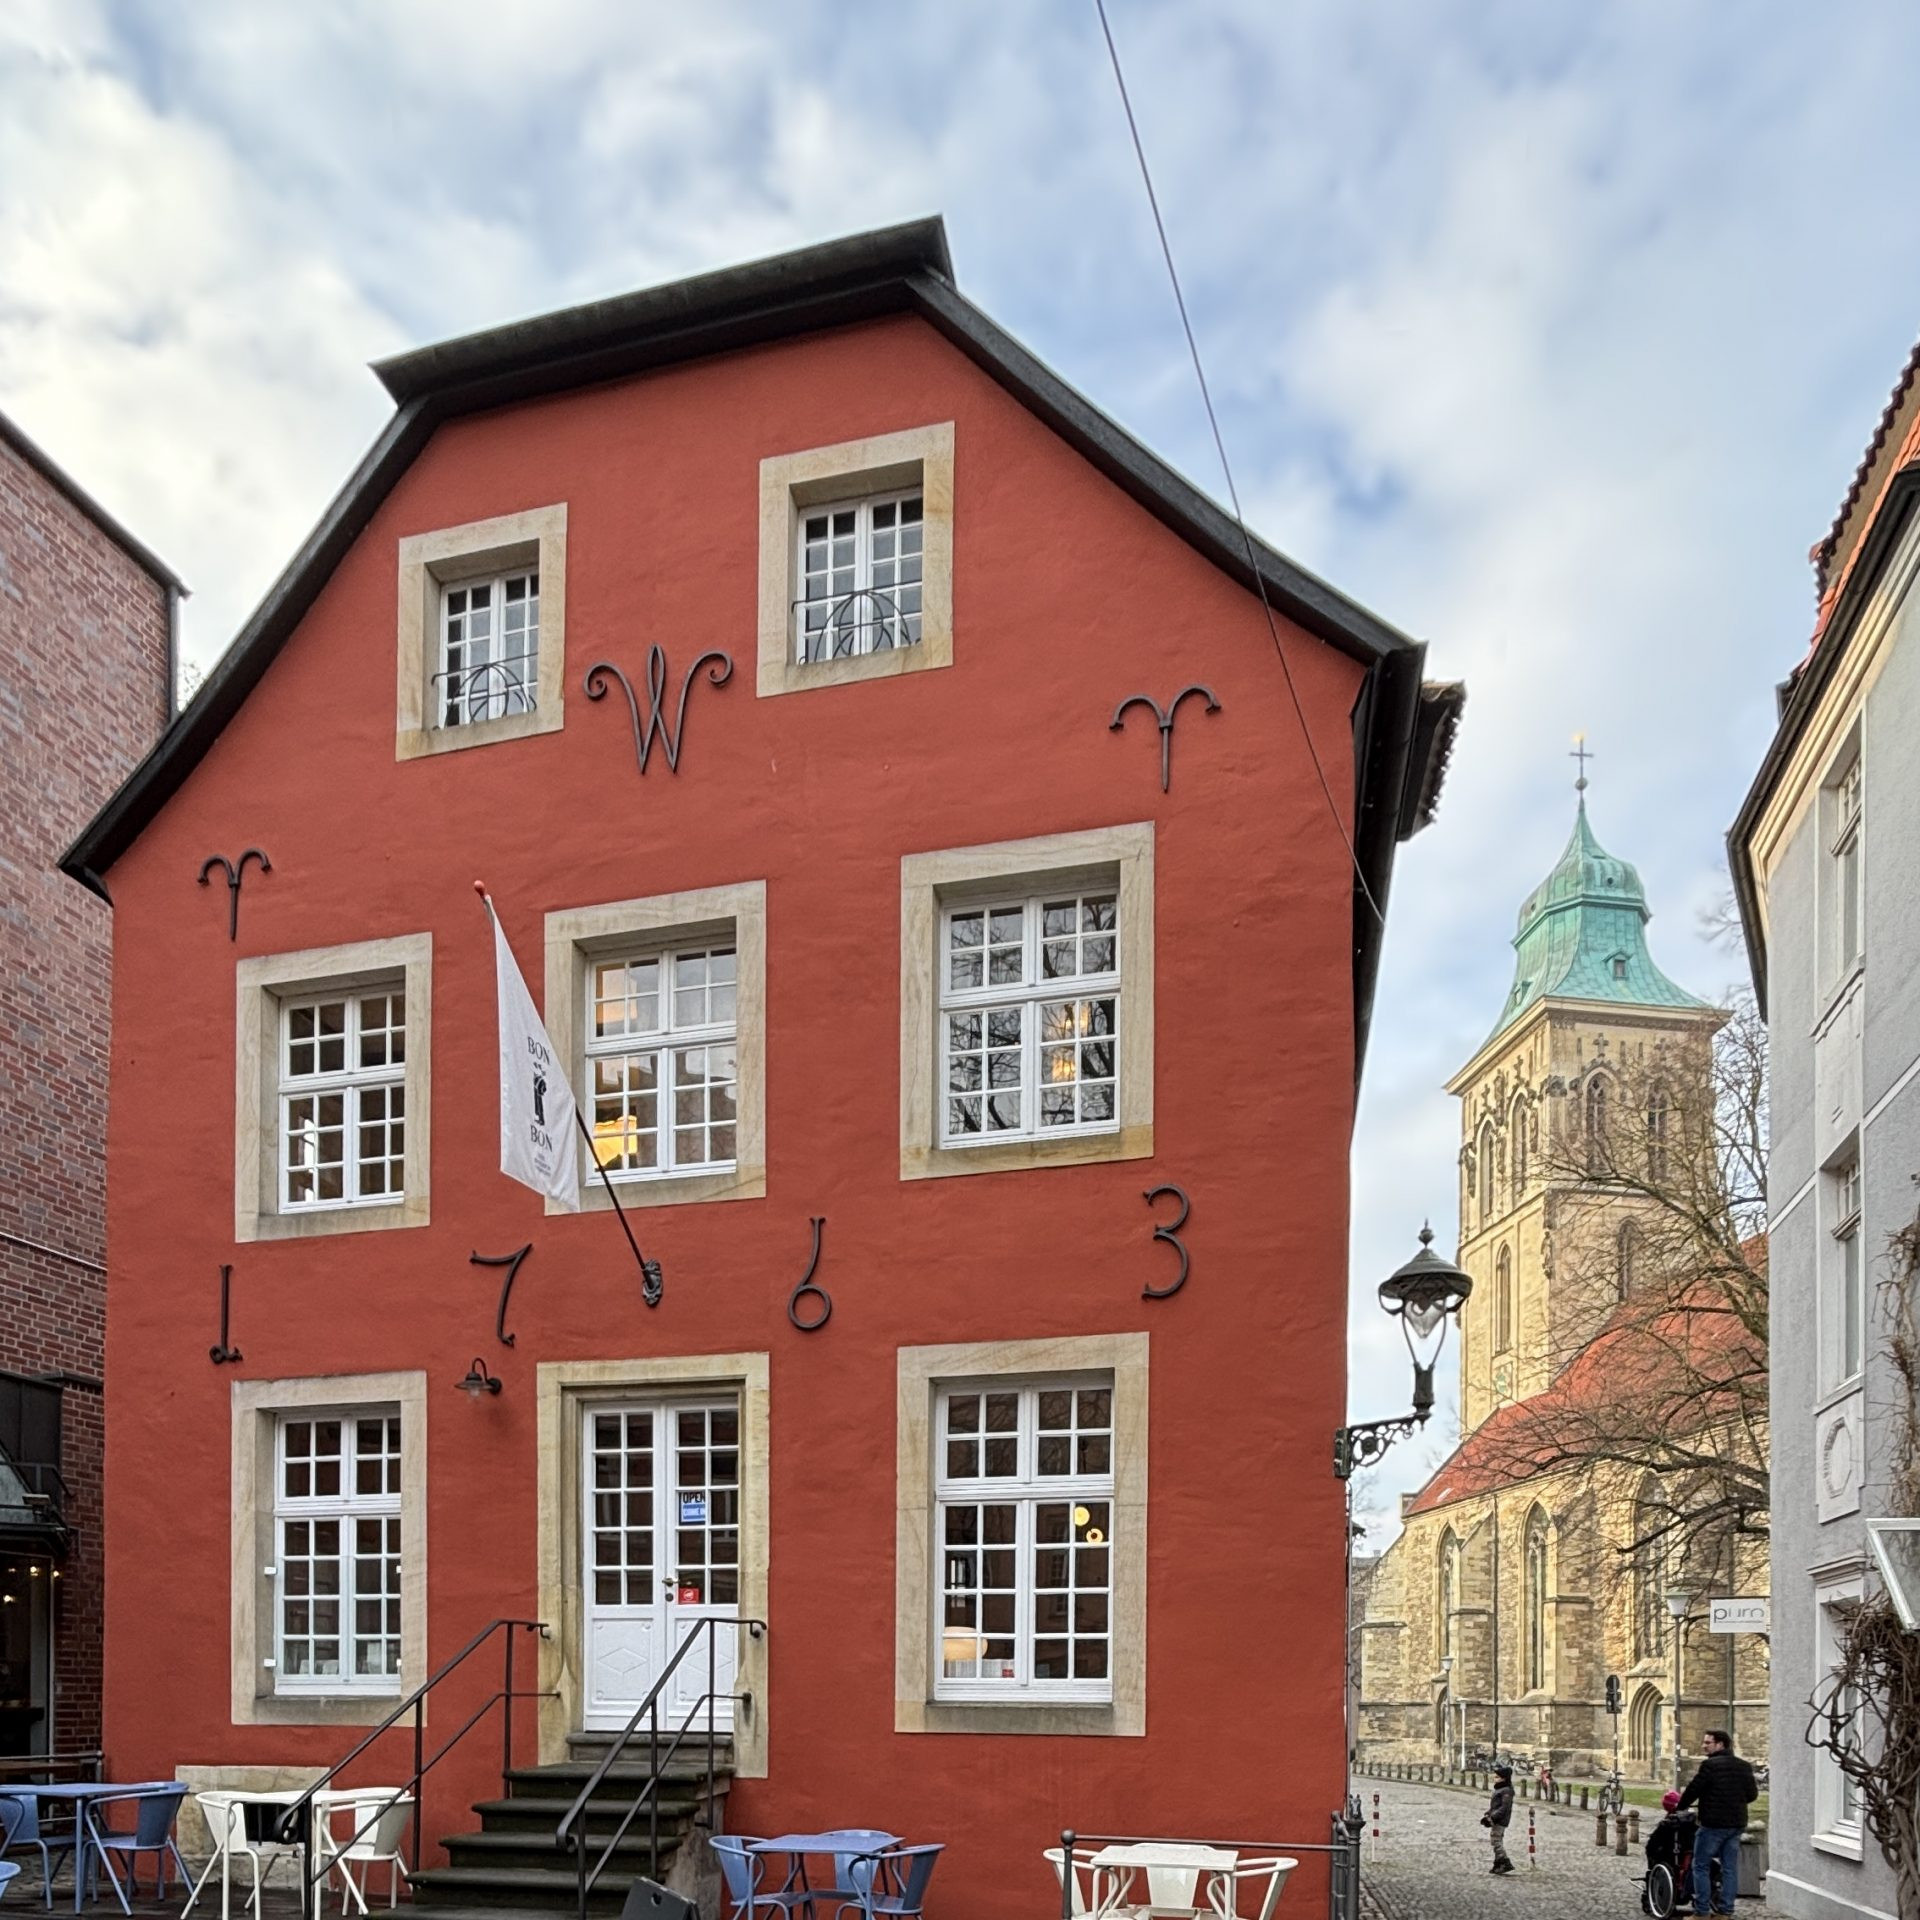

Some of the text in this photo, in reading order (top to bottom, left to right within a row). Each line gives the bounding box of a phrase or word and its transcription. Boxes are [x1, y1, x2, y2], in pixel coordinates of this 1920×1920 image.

[527, 1035, 550, 1066] BON
[530, 1124, 553, 1153] BON
[682, 1491, 706, 1504] OPEN
